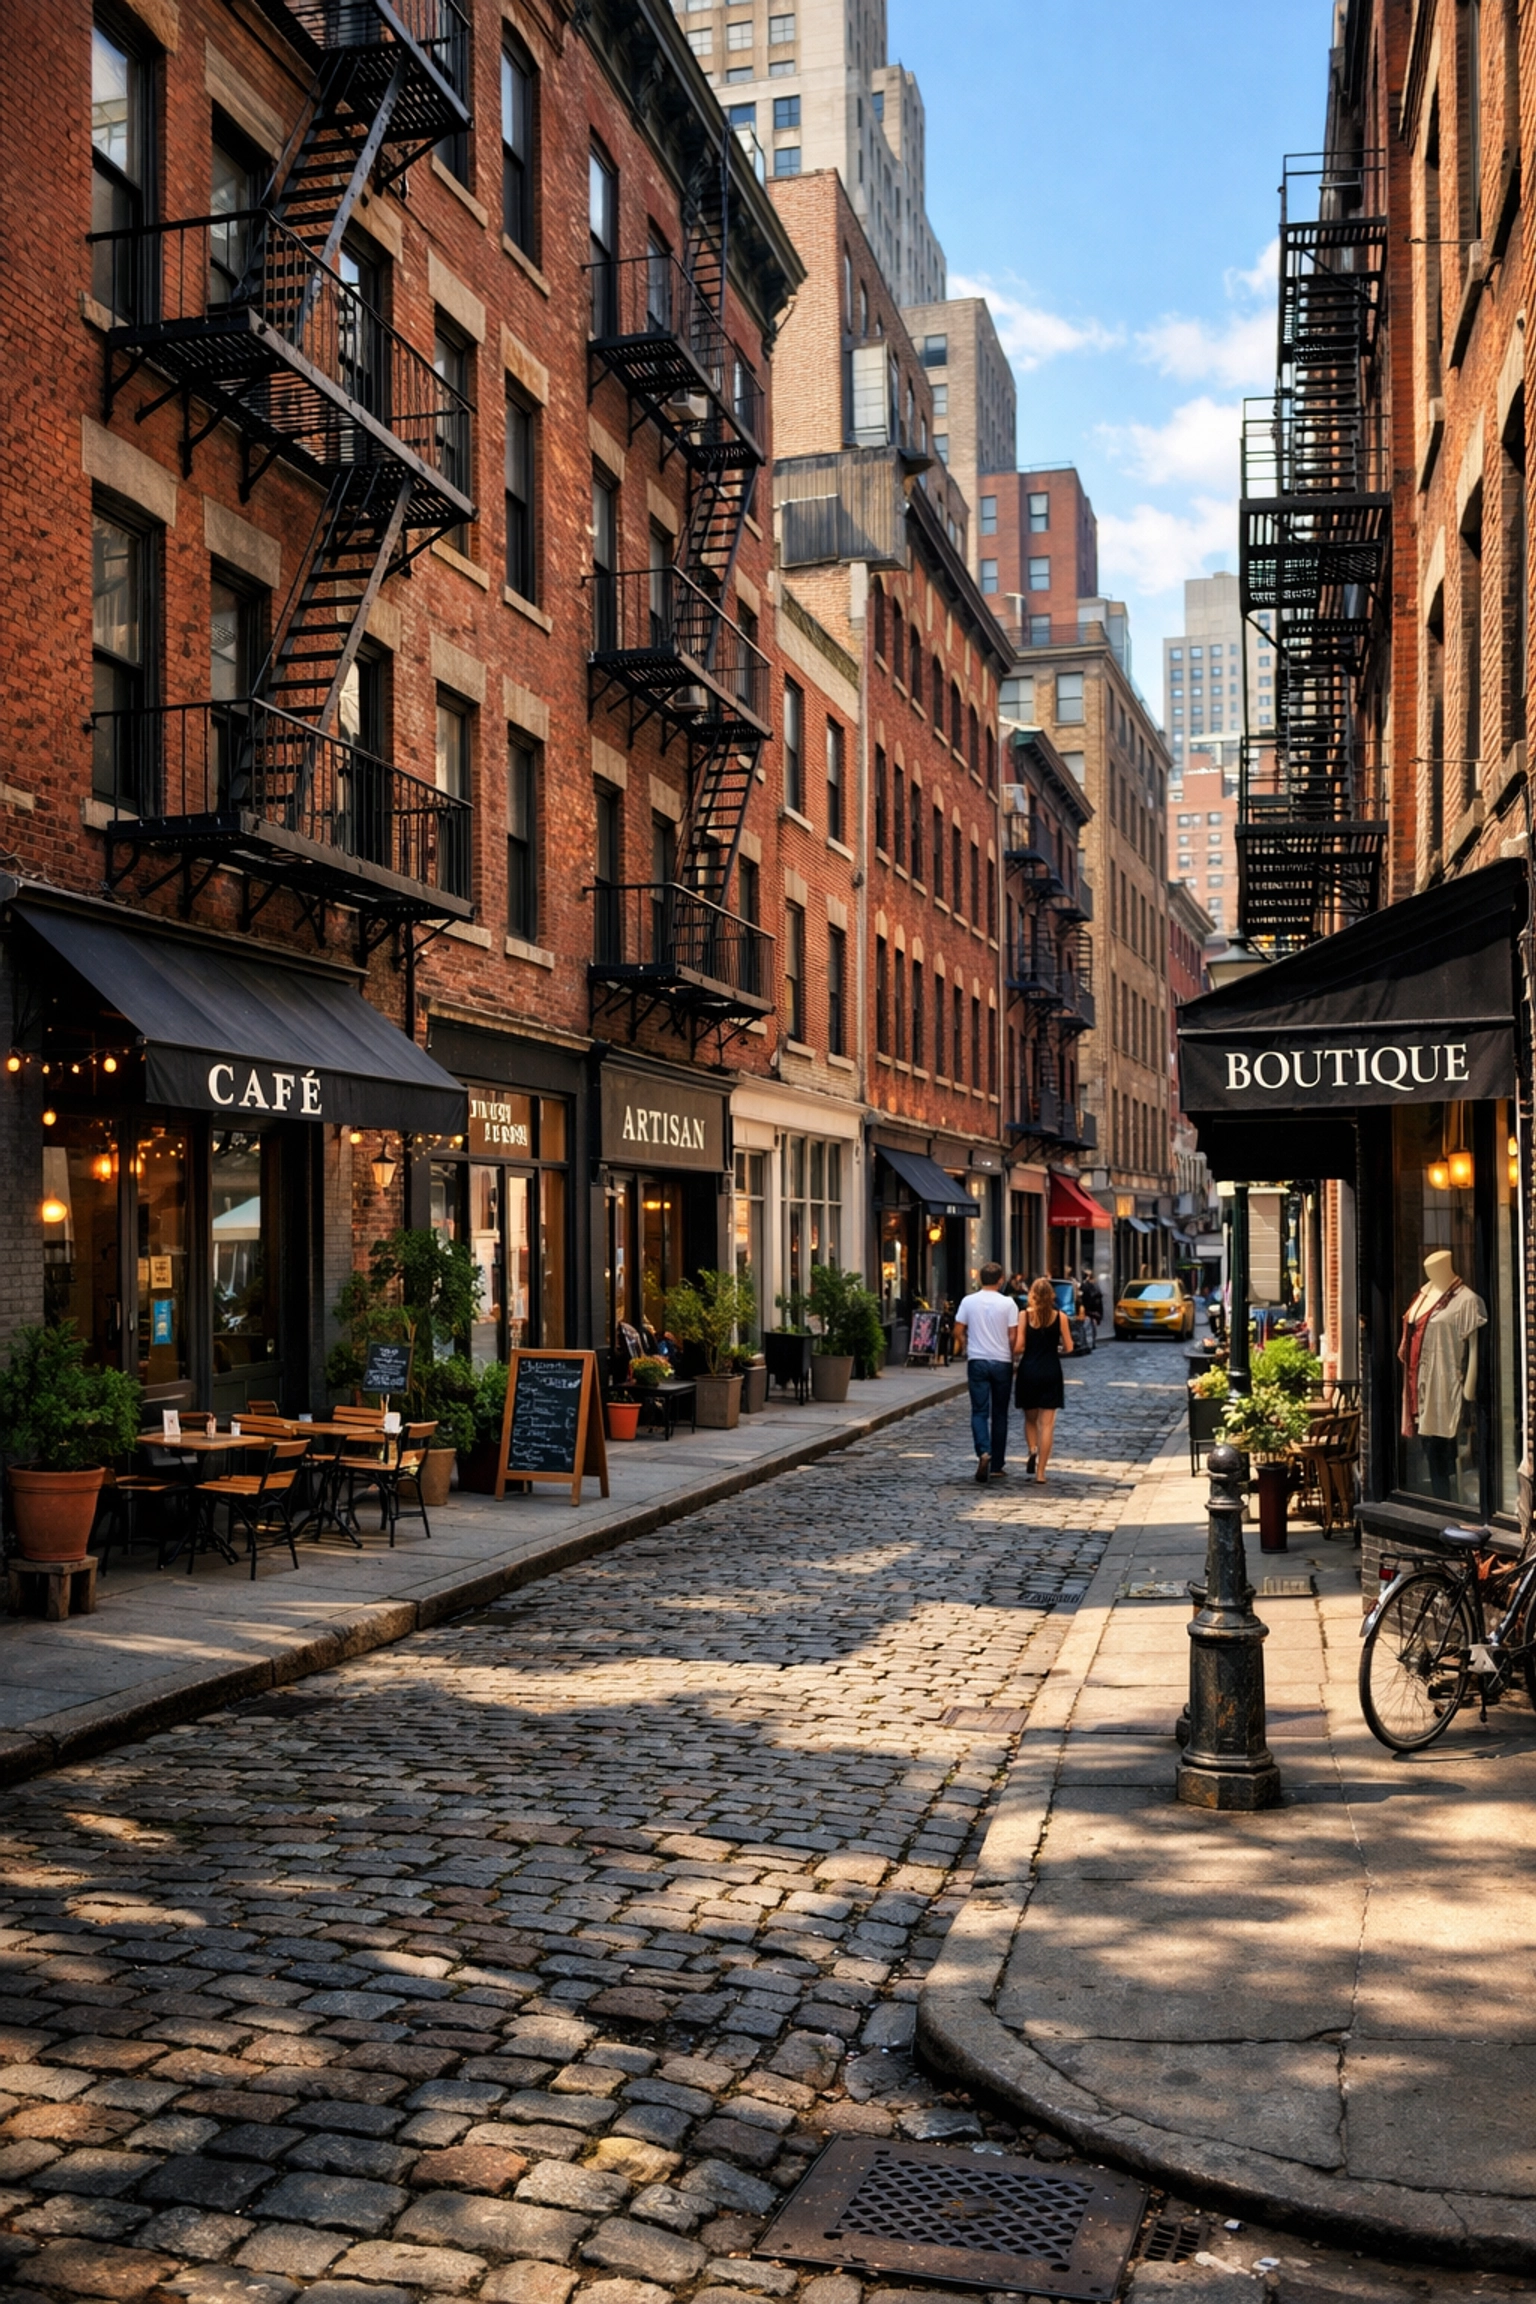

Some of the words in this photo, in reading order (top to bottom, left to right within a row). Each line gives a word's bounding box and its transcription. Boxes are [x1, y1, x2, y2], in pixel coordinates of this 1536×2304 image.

[208, 1063, 322, 1115] CAFÉ
[1225, 1043, 1470, 1091] BOUTIQUE
[622, 1105, 705, 1150] ARTISAN
